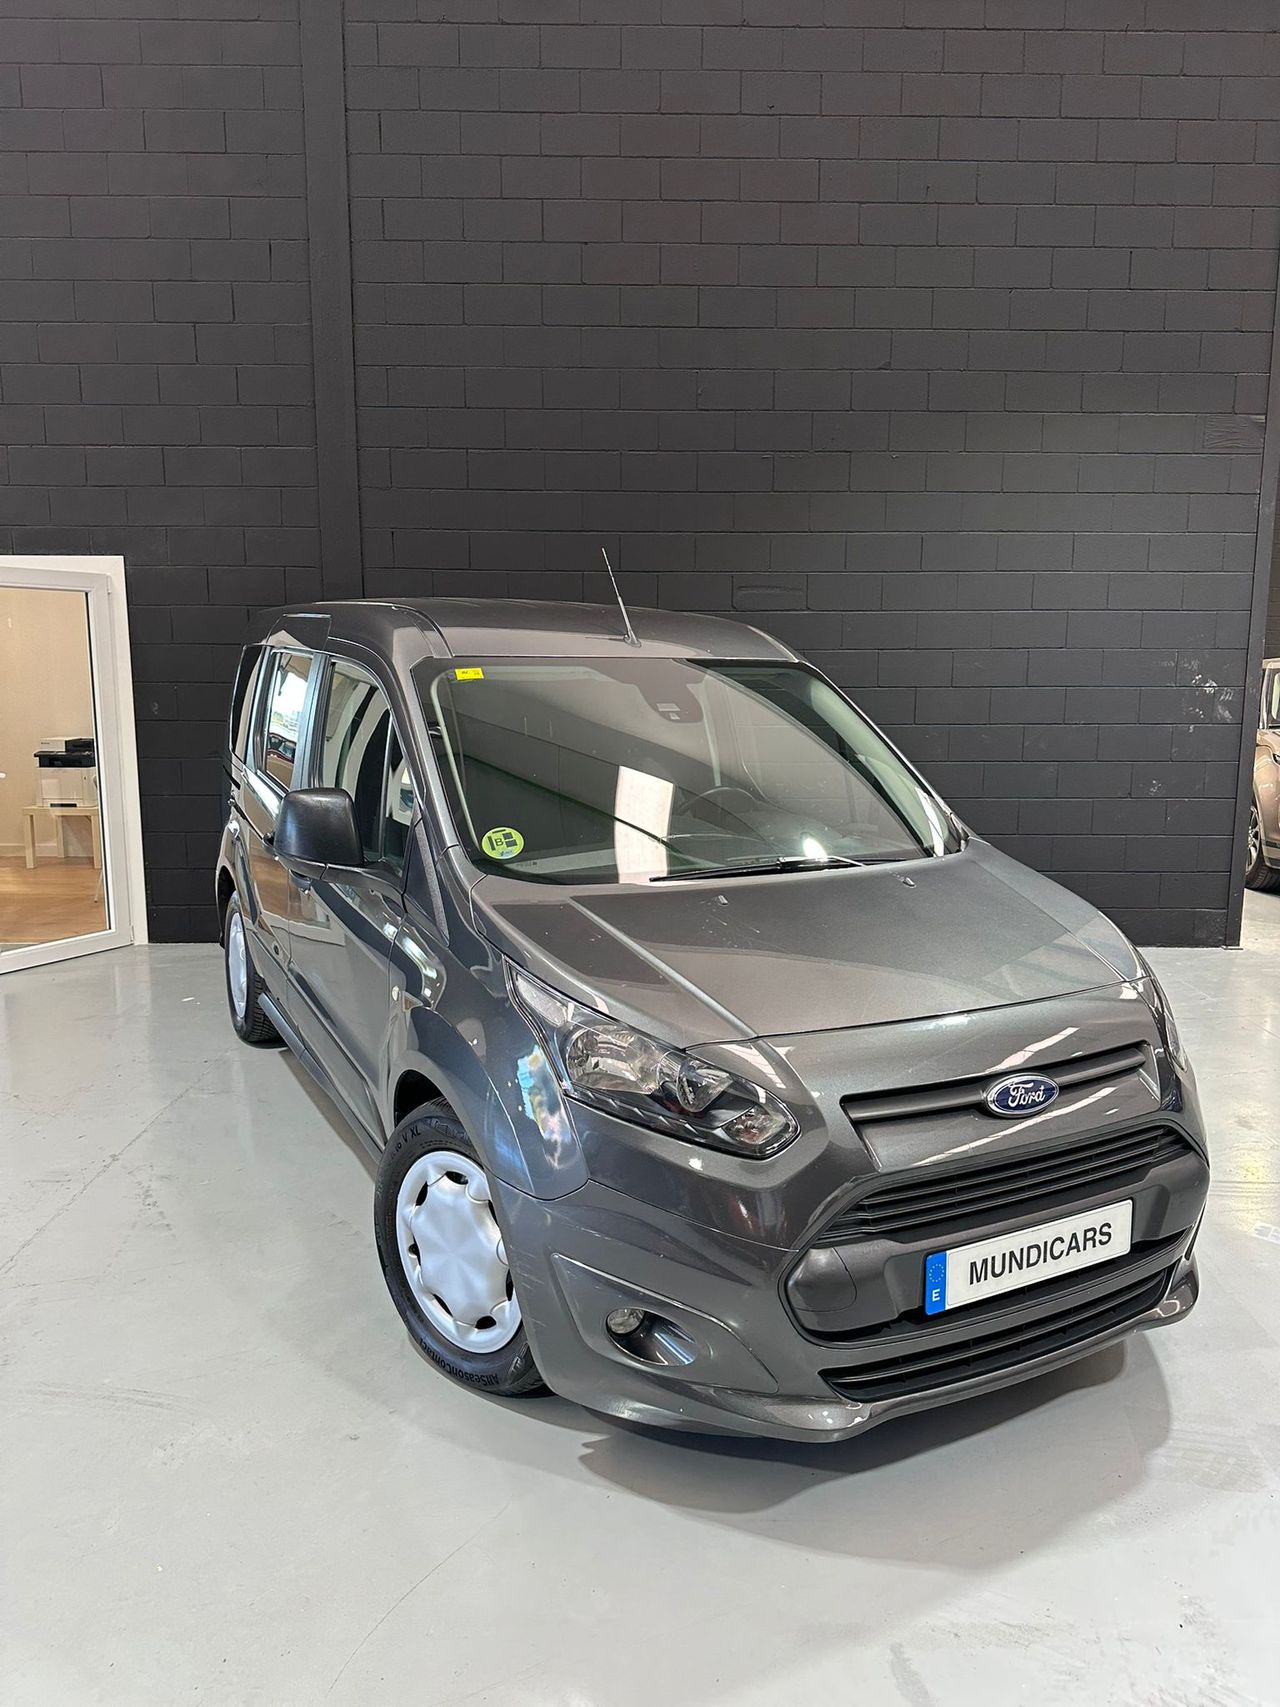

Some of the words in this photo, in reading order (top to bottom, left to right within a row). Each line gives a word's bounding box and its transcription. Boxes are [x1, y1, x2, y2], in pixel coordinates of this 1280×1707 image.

[495, 838, 504, 846] B
[1008, 1082, 1046, 1107] Ford
[410, 1124, 421, 1139] XL
[969, 1222, 1112, 1285] MUNDICARS
[932, 1289, 940, 1302] E
[419, 1338, 500, 1387] AllSeasonContact
